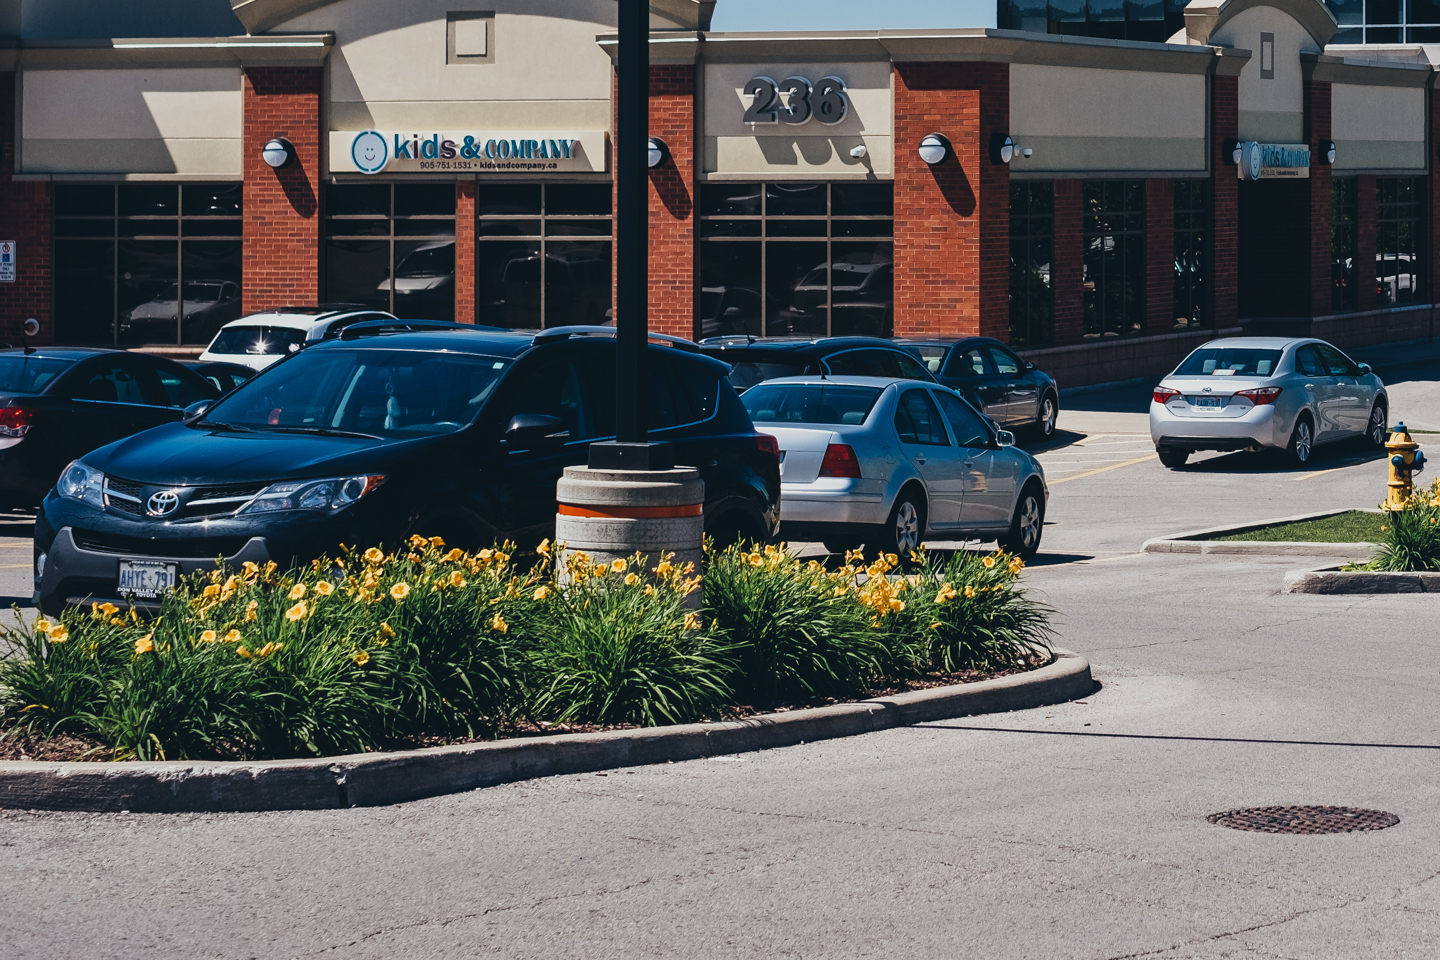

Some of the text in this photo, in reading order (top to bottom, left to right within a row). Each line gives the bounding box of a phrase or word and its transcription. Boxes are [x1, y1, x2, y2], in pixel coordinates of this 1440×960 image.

[743, 76, 848, 125] 236
[394, 134, 576, 160] kids & COMPANY
[420, 161, 557, 170] 905-751-1531 kidsandcompany.ca
[121, 570, 174, 588] AHYE 791
